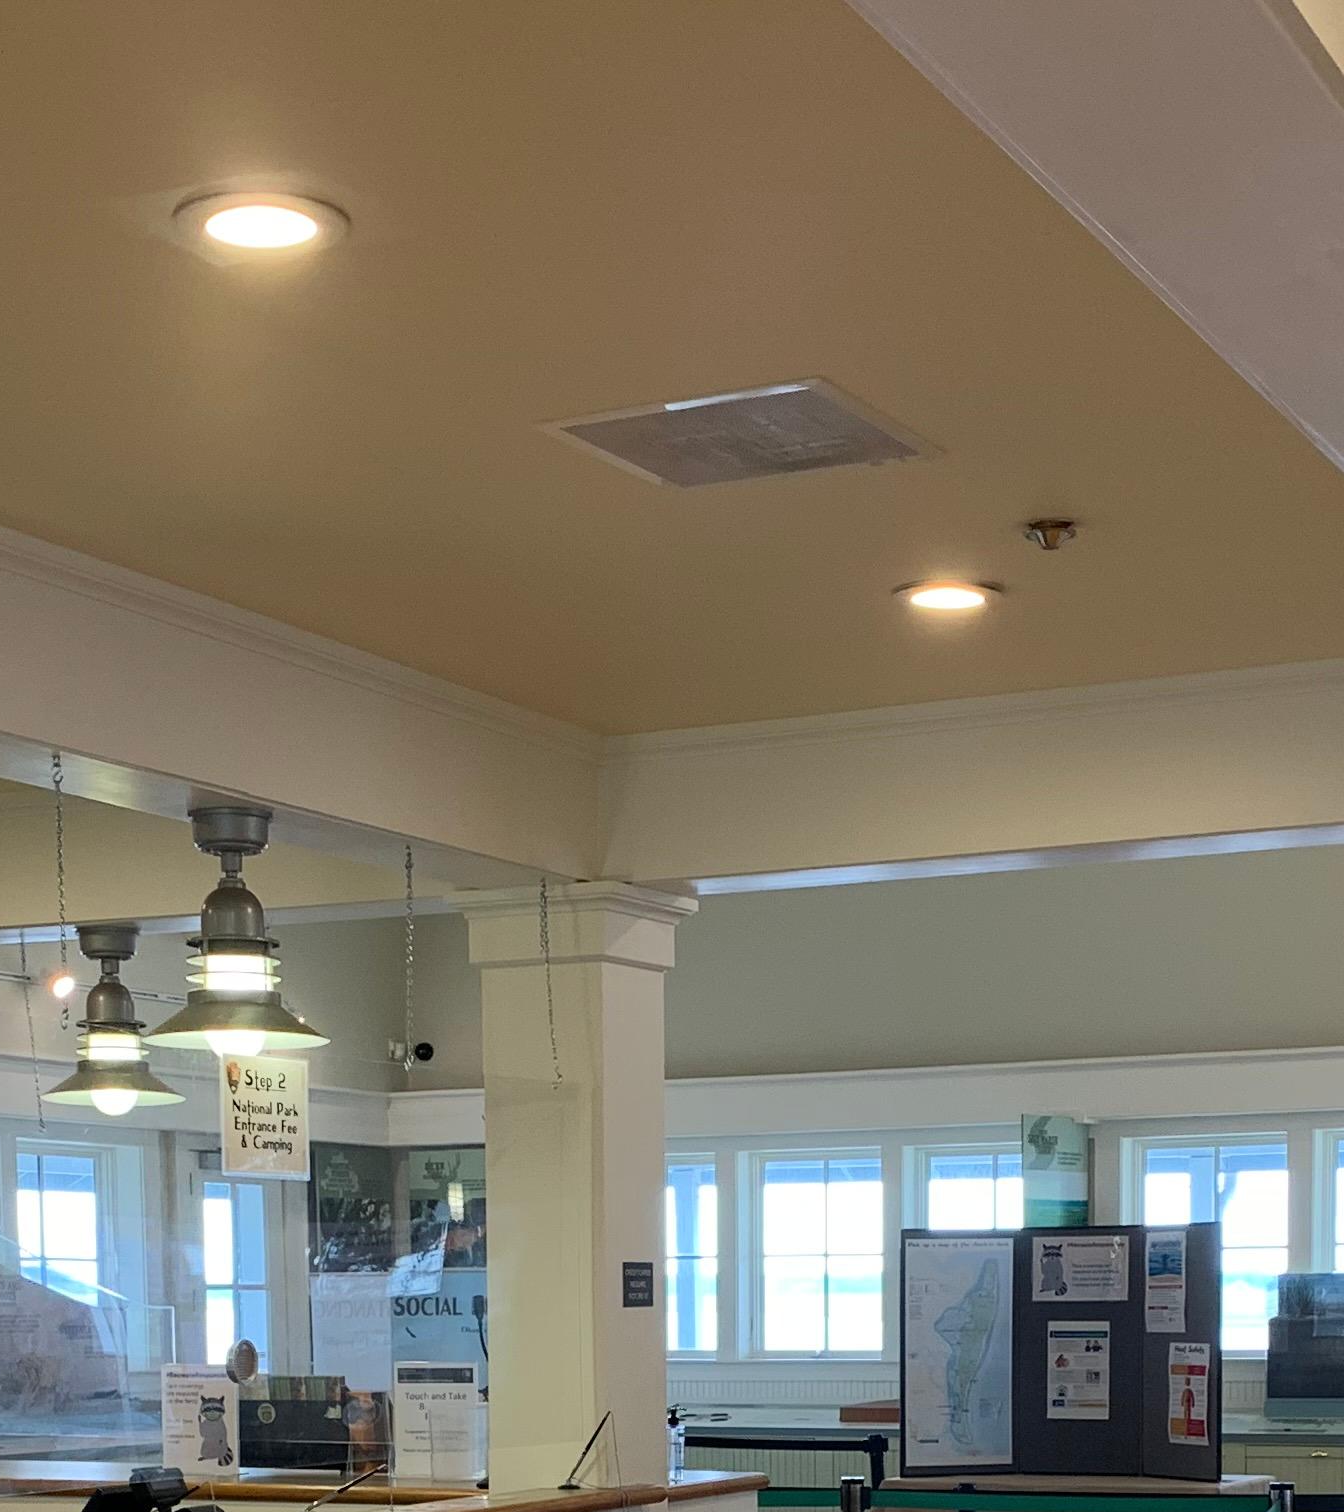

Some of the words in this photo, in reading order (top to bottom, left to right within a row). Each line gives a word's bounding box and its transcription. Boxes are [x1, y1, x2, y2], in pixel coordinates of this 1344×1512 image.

[244, 1069, 273, 1091] Step
[278, 1073, 286, 1088] 2
[232, 1099, 273, 1117] National
[276, 1102, 298, 1117] Park
[234, 1116, 277, 1134] Entrance
[281, 1119, 297, 1134] Fee
[253, 1135, 293, 1154] Camping
[393, 1297, 463, 1317] SOCIAL
[405, 1392, 429, 1400] Touch
[431, 1392, 446, 1400] and
[448, 1392, 467, 1400] Take
